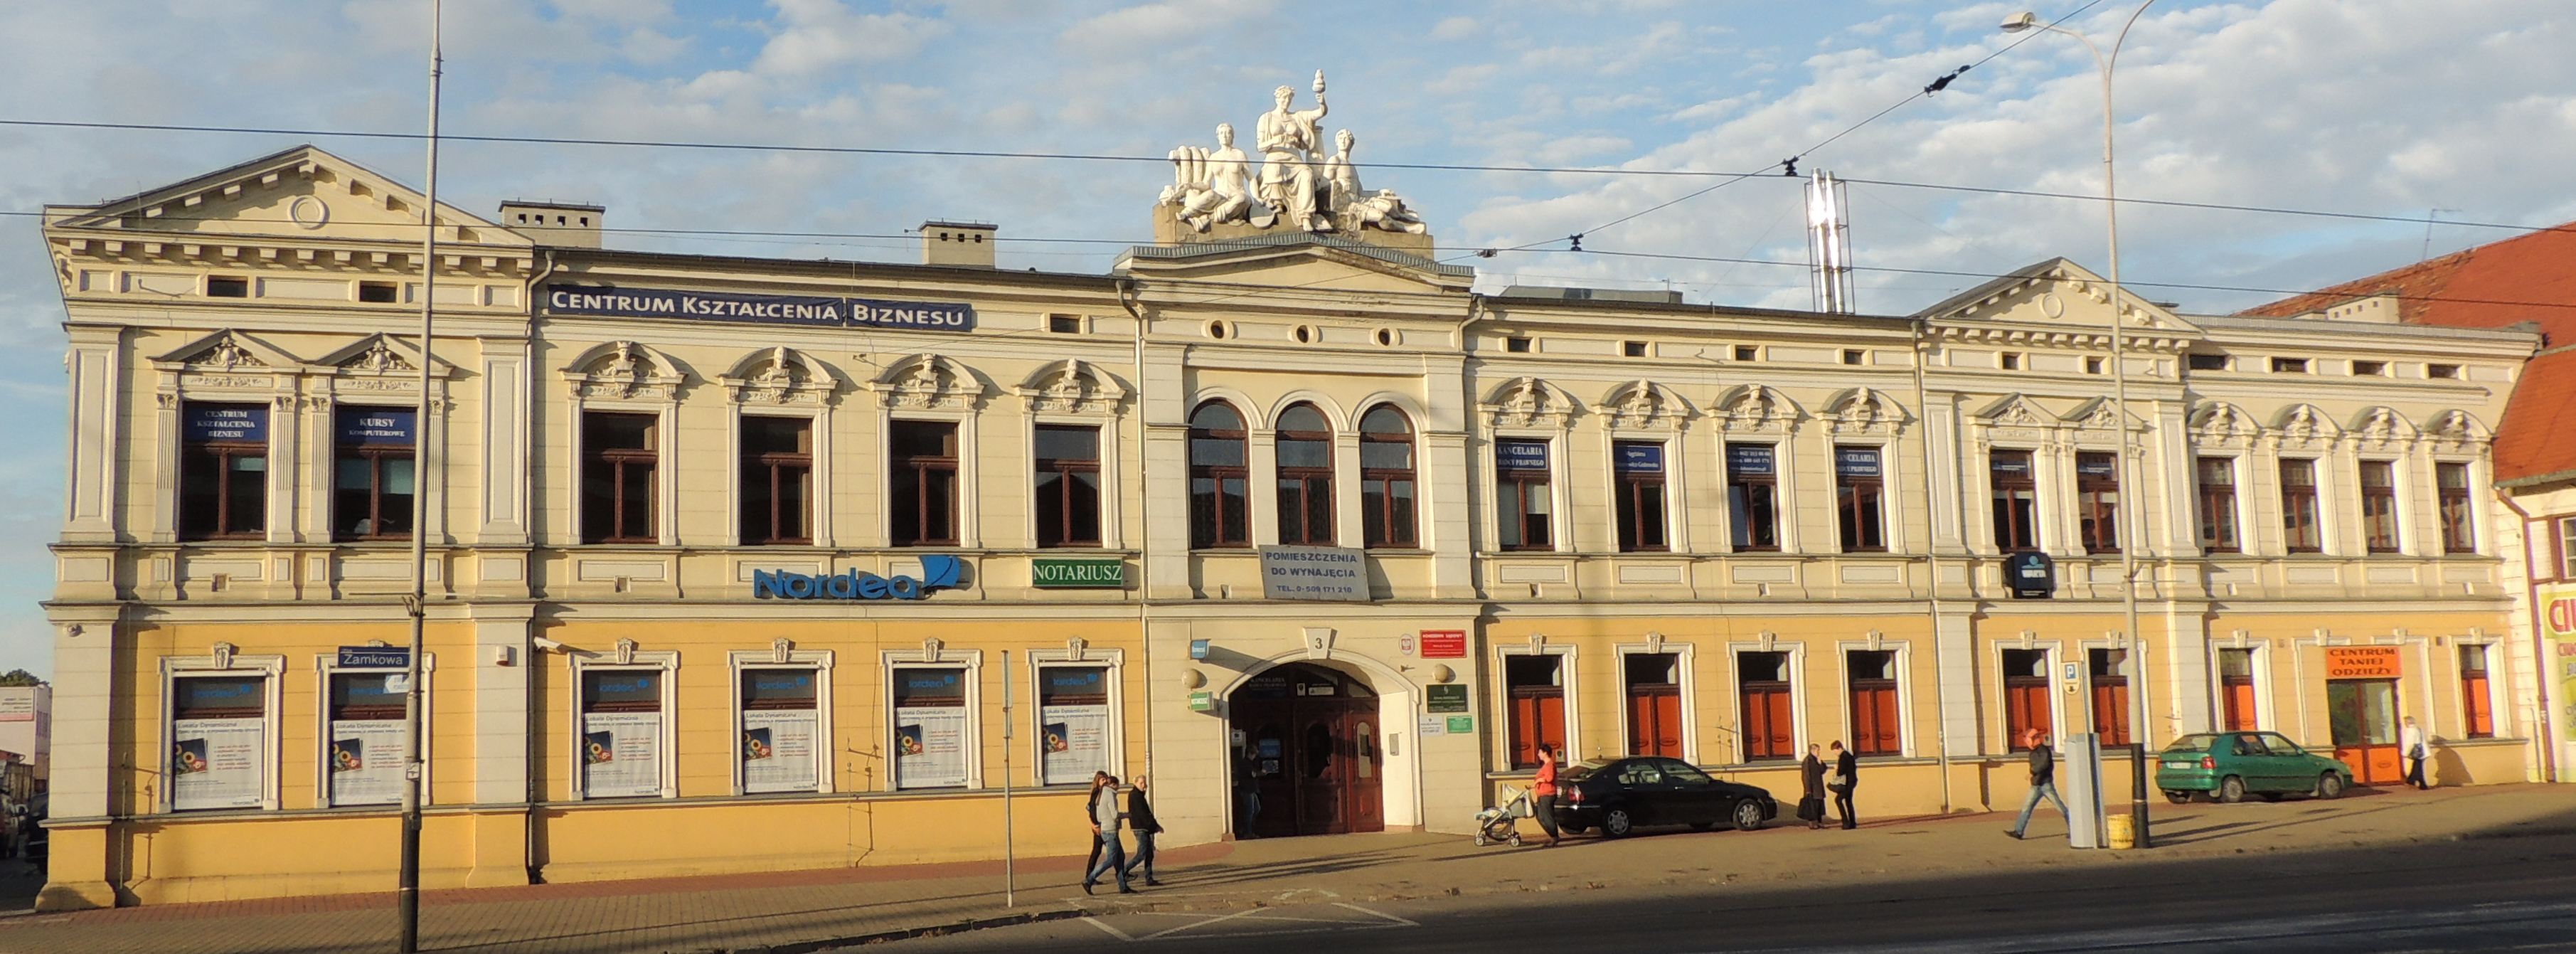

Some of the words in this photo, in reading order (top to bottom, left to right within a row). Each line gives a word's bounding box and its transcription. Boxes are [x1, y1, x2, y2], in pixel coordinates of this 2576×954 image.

[552, 291, 675, 313] CENTRUM
[683, 297, 839, 320] KSZTAŁCENIA
[853, 304, 963, 326] BIZNESU
[359, 418, 395, 427] KURSY
[1497, 446, 1543, 455] KANCELARIA
[1266, 552, 1358, 563] POMIESZCZENIA
[1033, 565, 1122, 581] NOTARIUSZ
[1271, 567, 1287, 576] DO
[1289, 568, 1356, 578] WYNAJĘCIA
[2021, 569, 2046, 578] WARTA
[754, 567, 917, 599] Nordea
[1314, 637, 1323, 650] 3
[2329, 648, 2395, 657] CENTRUM
[344, 654, 403, 665] Zamkowa
[2067, 665, 2074, 677] P
[2331, 667, 2391, 676] ODZIEŻY
